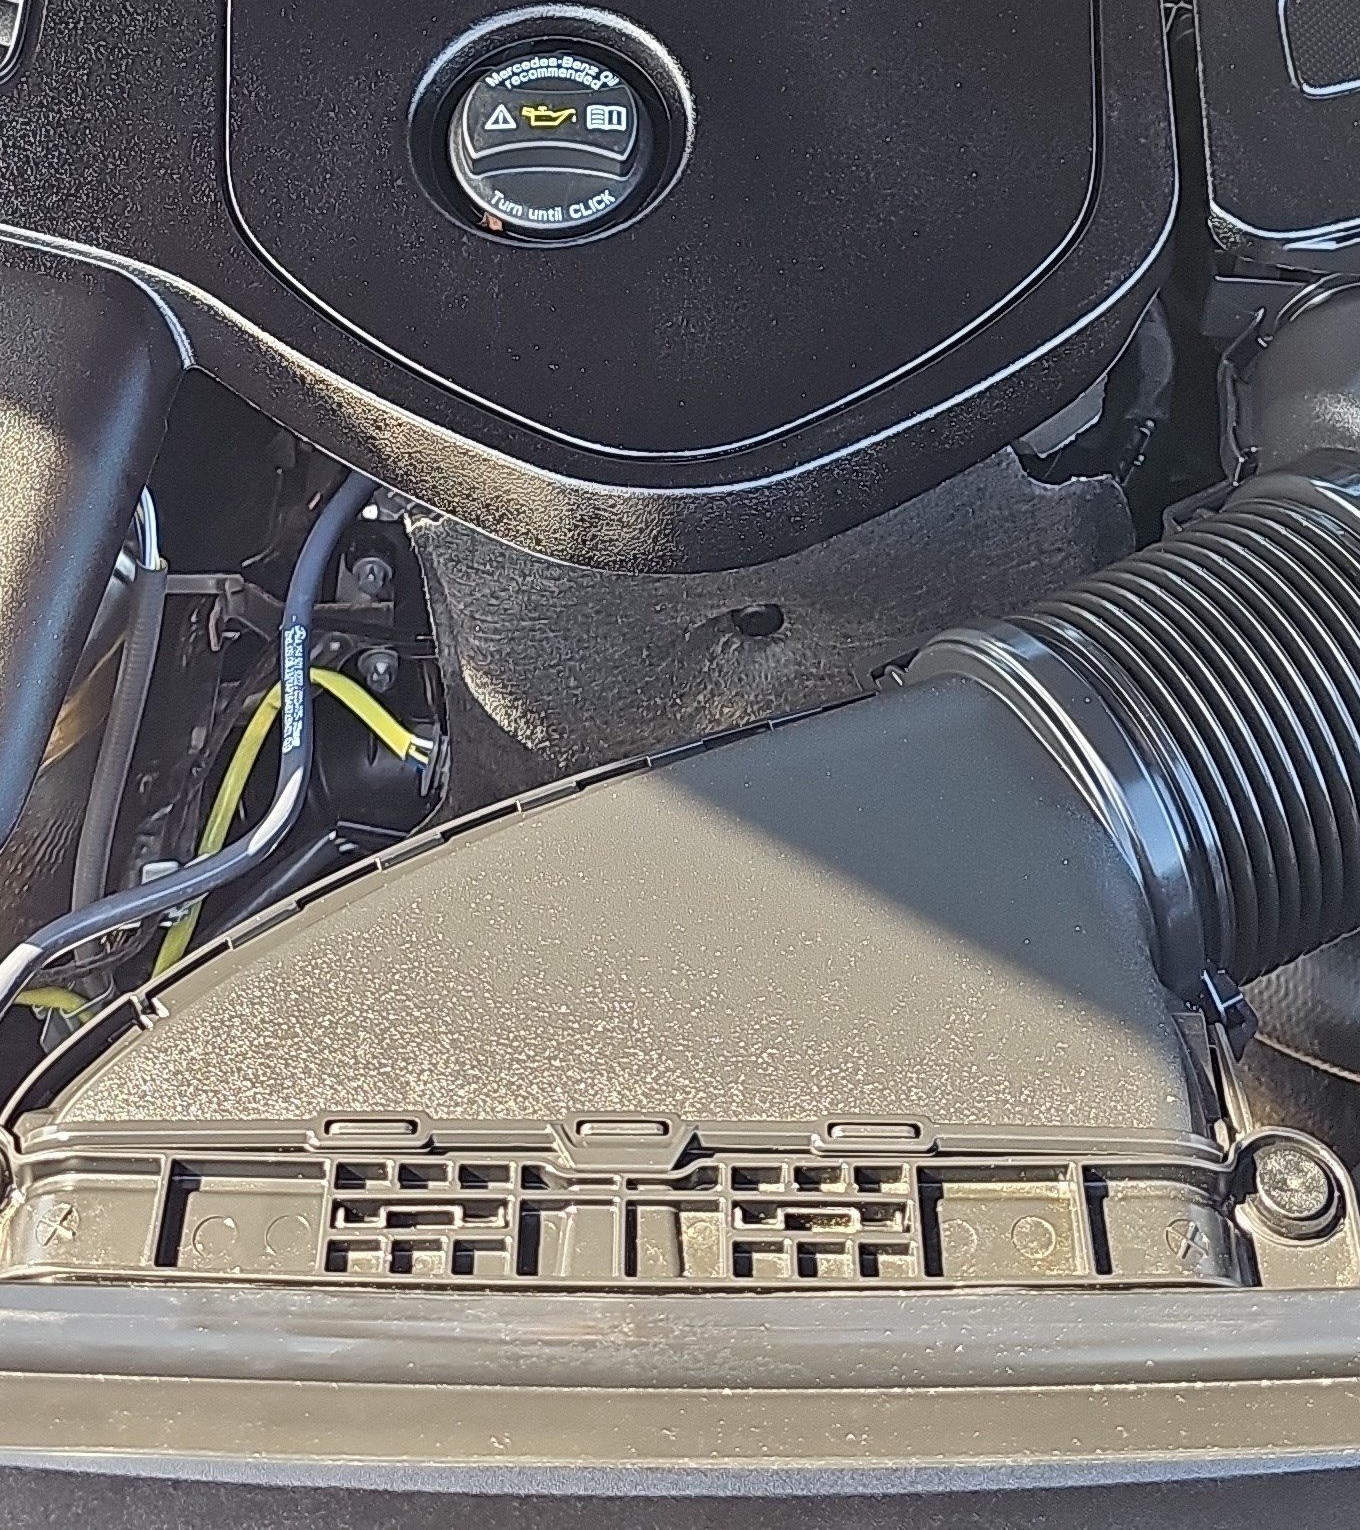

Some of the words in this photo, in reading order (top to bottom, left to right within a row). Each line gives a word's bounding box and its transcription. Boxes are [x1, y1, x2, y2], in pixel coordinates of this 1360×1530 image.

[485, 55, 599, 87] Mercedes-Benz
[600, 70, 619, 87] Oil
[504, 67, 604, 90] recommended
[491, 190, 523, 217] Turn
[528, 206, 563, 222] until
[569, 189, 617, 219] CLICK
